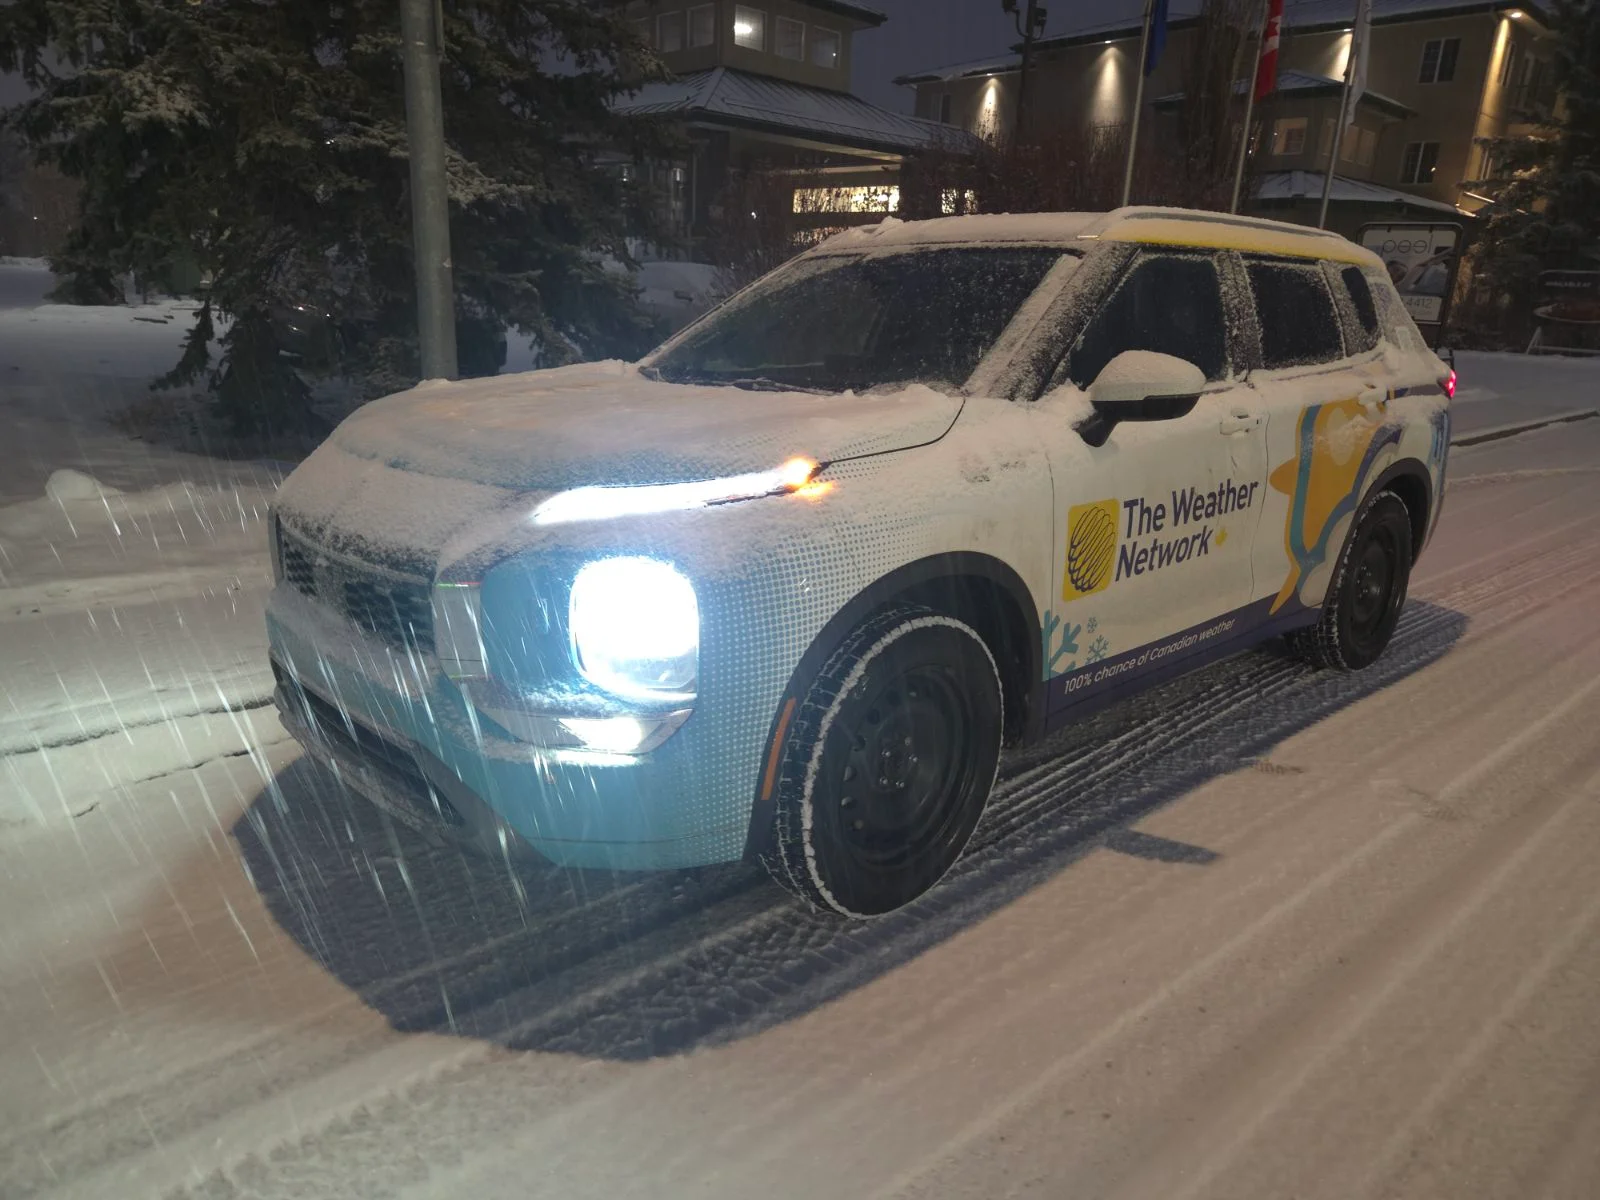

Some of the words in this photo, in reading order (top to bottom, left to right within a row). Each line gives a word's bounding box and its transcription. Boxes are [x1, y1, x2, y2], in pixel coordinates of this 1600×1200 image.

[1380, 233, 1433, 257] peel
[1123, 497, 1165, 538] The
[1171, 479, 1259, 526] Weather
[1115, 526, 1213, 582] Network
[1064, 672, 1092, 694] 100%
[1095, 658, 1136, 682] chance
[1137, 650, 1150, 665] of
[1150, 635, 1198, 660] Canadian
[1199, 619, 1235, 641] weather
